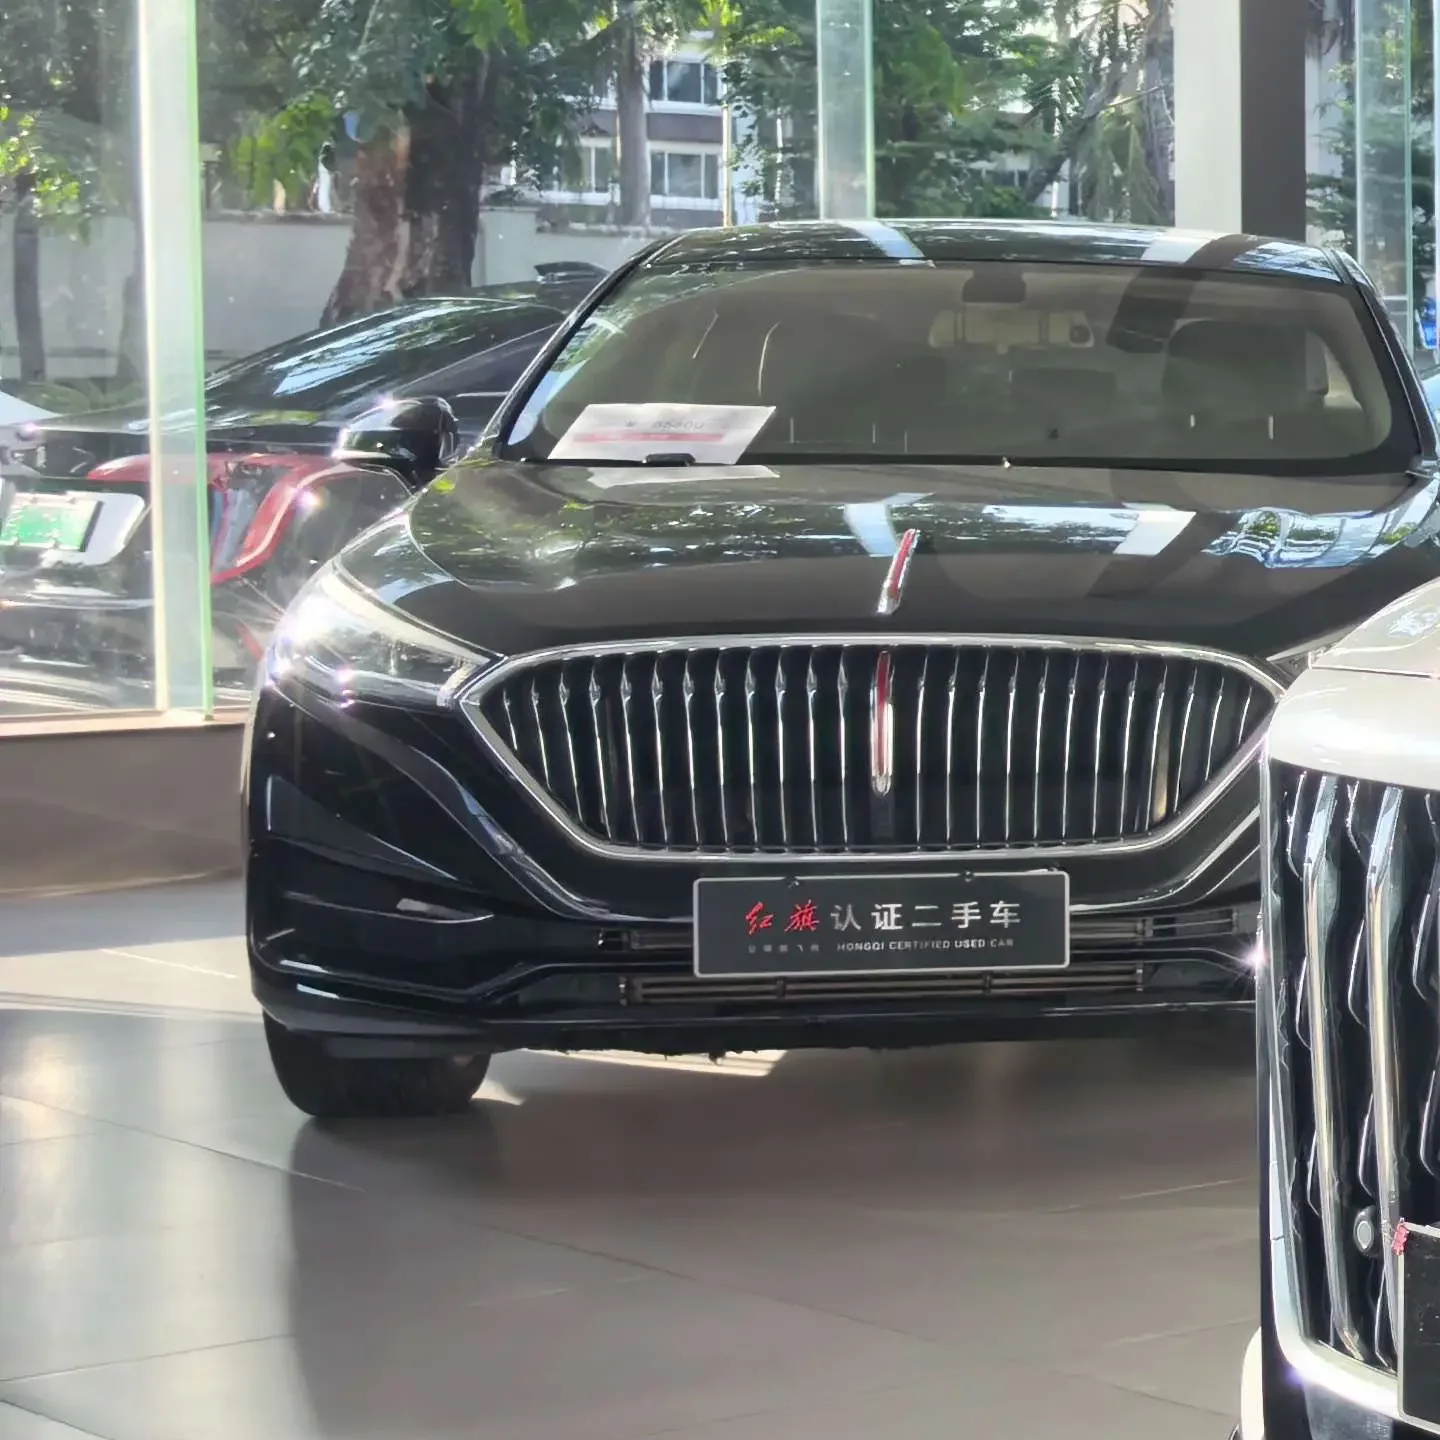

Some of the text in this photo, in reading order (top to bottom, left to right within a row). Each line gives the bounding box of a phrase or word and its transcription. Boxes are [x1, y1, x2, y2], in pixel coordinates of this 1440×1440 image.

[744, 898, 1021, 936] 红旗认证二手车
[836, 942, 885, 952] HONGQI
[954, 938, 986, 949] USED
